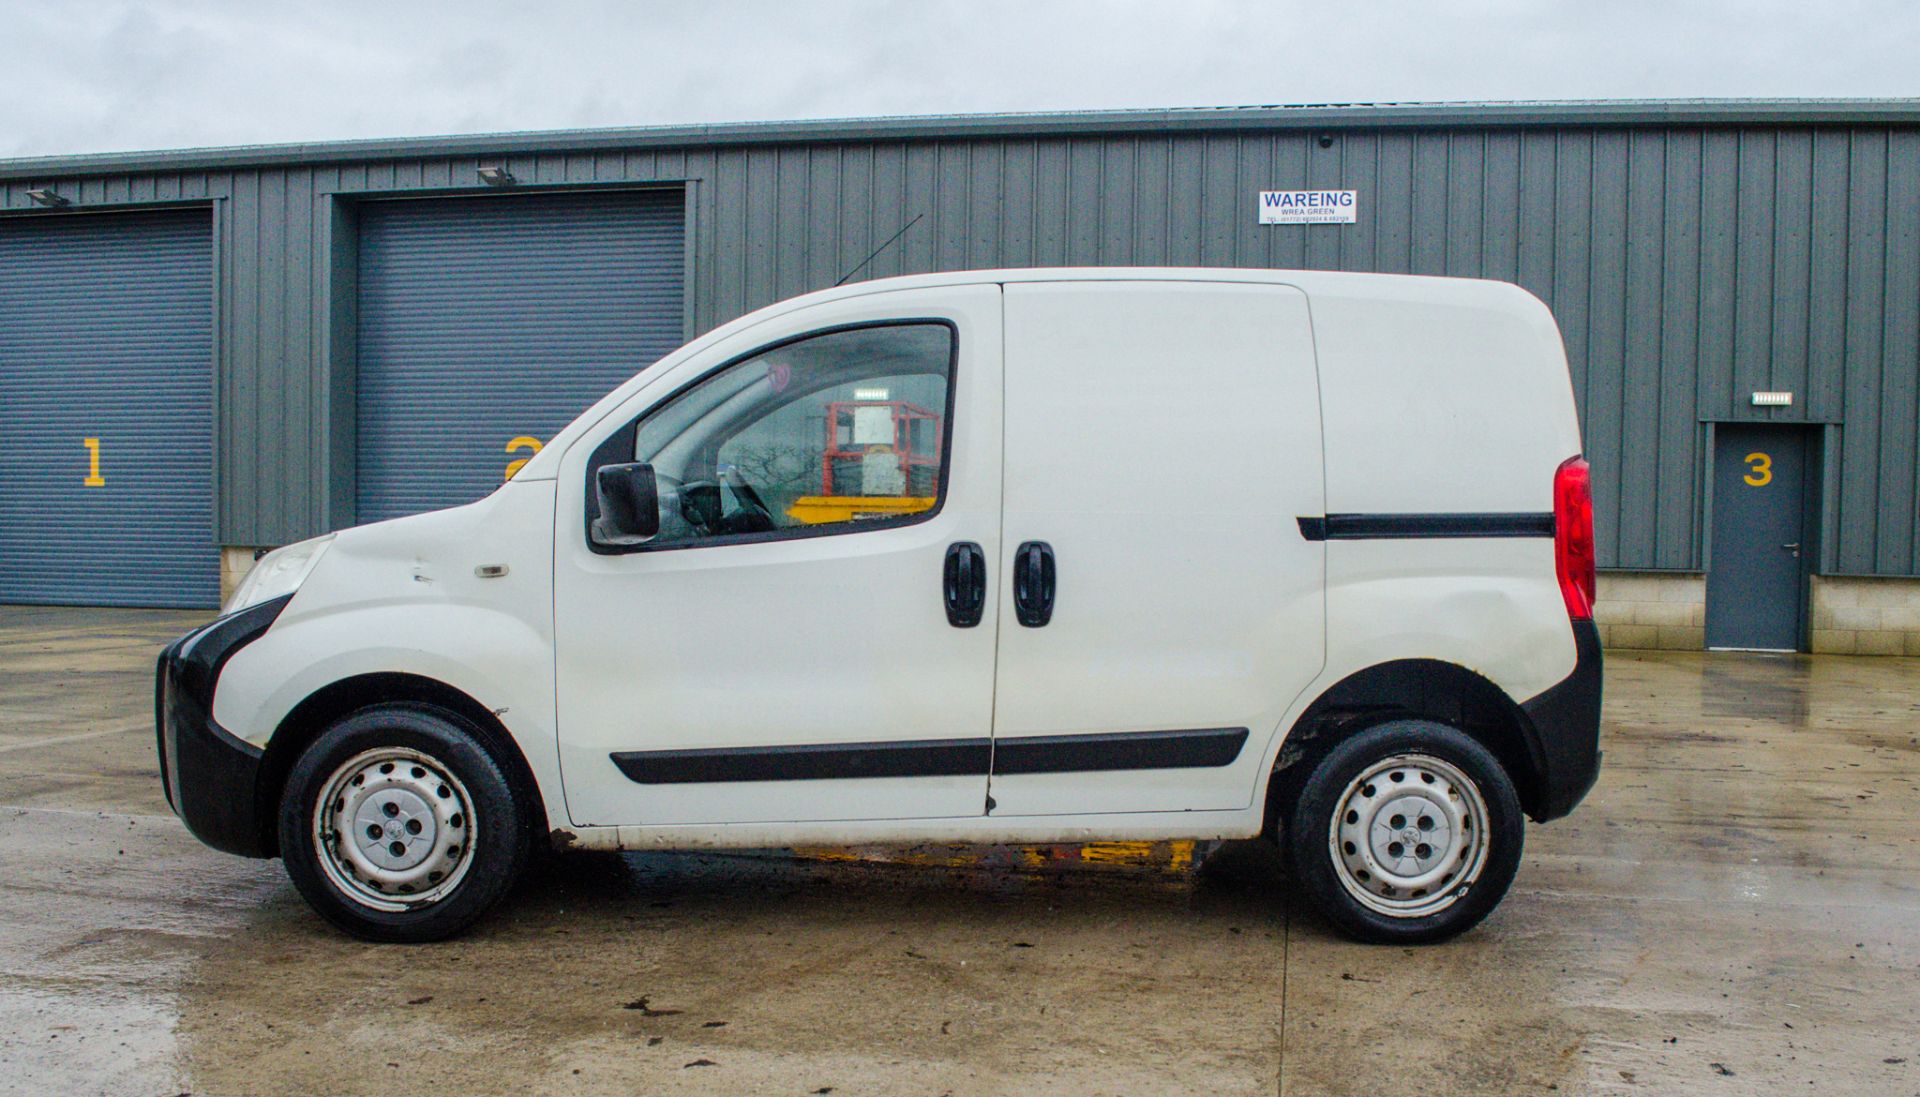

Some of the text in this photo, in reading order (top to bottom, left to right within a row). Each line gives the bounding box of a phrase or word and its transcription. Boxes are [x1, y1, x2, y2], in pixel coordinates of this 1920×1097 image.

[1264, 192, 1352, 207] WAREING
[84, 438, 105, 486] 1
[1744, 452, 1772, 487] 3
